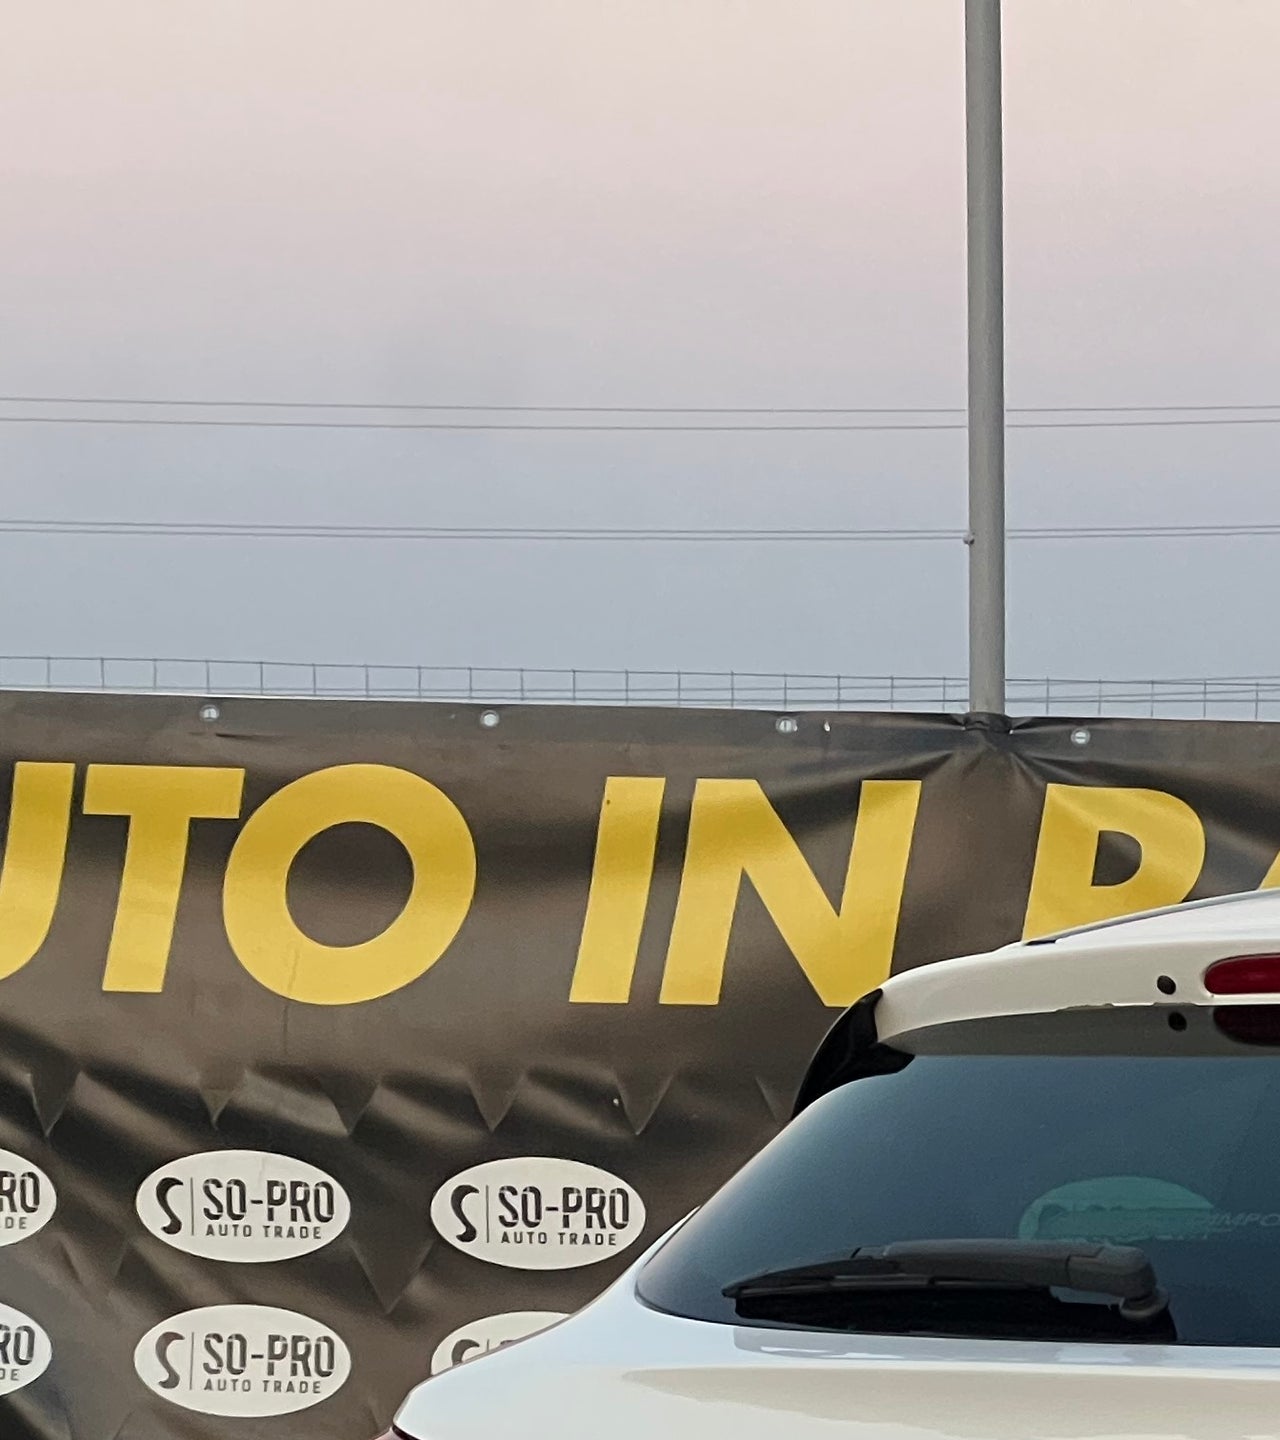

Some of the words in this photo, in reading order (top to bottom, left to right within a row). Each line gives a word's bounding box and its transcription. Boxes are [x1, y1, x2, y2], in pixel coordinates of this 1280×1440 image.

[568, 776, 922, 1007] IN
[203, 1177, 336, 1223] SO-PRO
[499, 1184, 630, 1229] SO-PRO
[206, 1224, 251, 1237] AUTO
[263, 1225, 321, 1239] TRADE
[501, 1232, 547, 1244] AUTO
[558, 1233, 616, 1245] TRADE
[203, 1331, 337, 1377] SO-PRO
[204, 1379, 251, 1392] AUTO
[263, 1380, 320, 1393] TRADE
